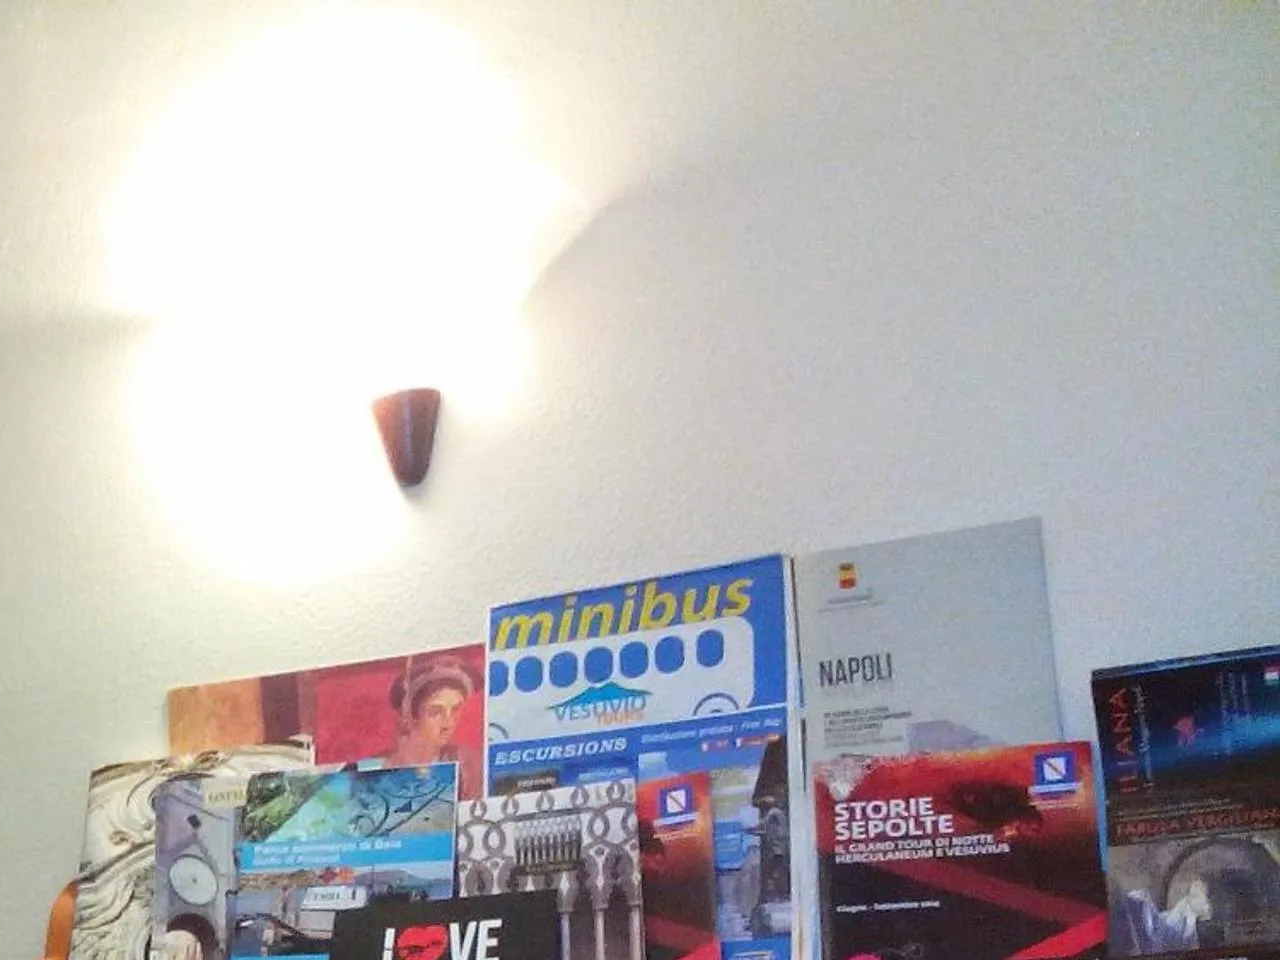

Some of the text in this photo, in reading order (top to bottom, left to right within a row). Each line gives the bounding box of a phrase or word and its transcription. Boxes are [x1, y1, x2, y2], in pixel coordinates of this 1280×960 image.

[494, 577, 754, 650] minibus
[818, 652, 893, 687] NAPOLI
[554, 693, 646, 722] VESUVIO
[494, 735, 628, 766] ESCURSIONS
[834, 797, 934, 823] STORIE
[834, 814, 955, 841] SEPOLTE
[835, 849, 934, 864] HERCULANEUM
[849, 842, 895, 854] GRAND
[897, 839, 933, 851] TOUR
[951, 834, 995, 846] NOTTE
